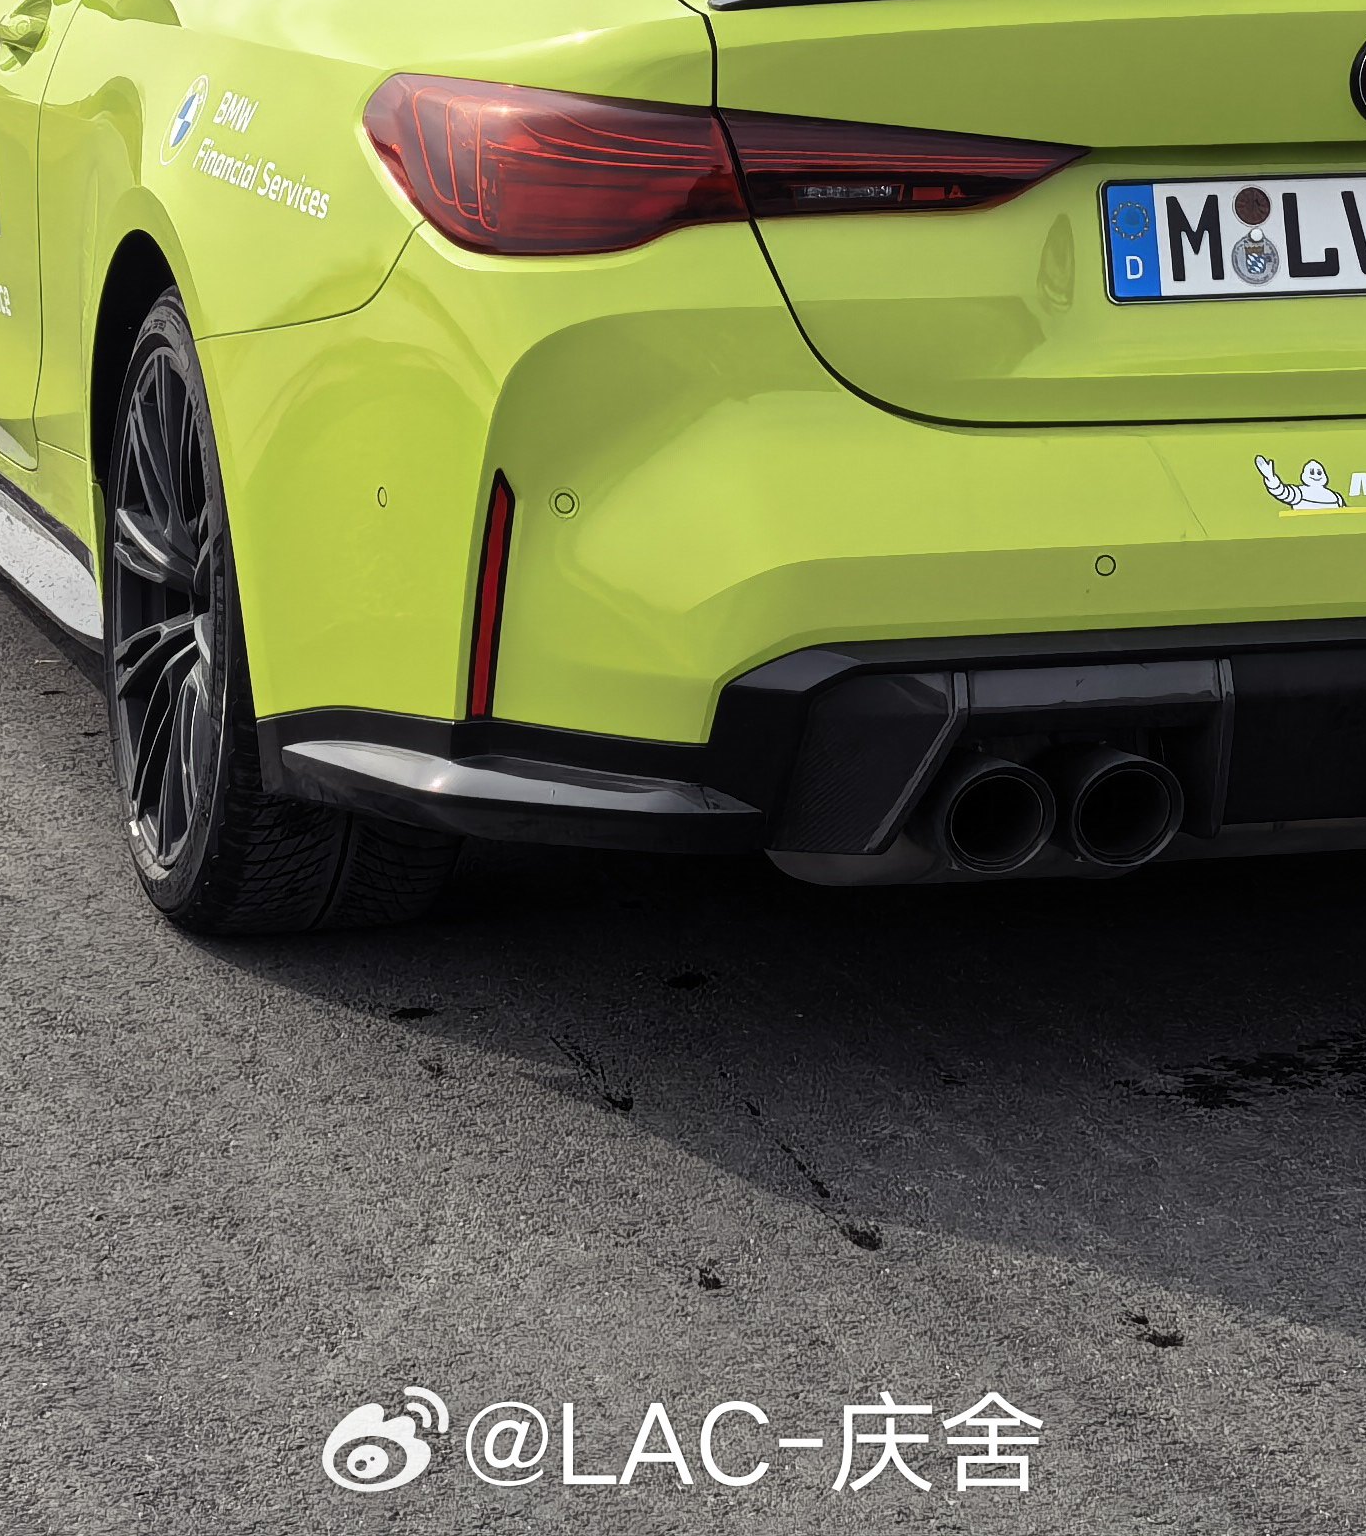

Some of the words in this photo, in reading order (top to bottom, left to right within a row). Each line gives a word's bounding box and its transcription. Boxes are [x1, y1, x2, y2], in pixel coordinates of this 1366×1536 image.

[212, 90, 260, 134] BMW
[192, 137, 263, 191] Financial
[256, 161, 331, 220] Services
[1124, 255, 1143, 280] D
[1165, 194, 1225, 282] M
